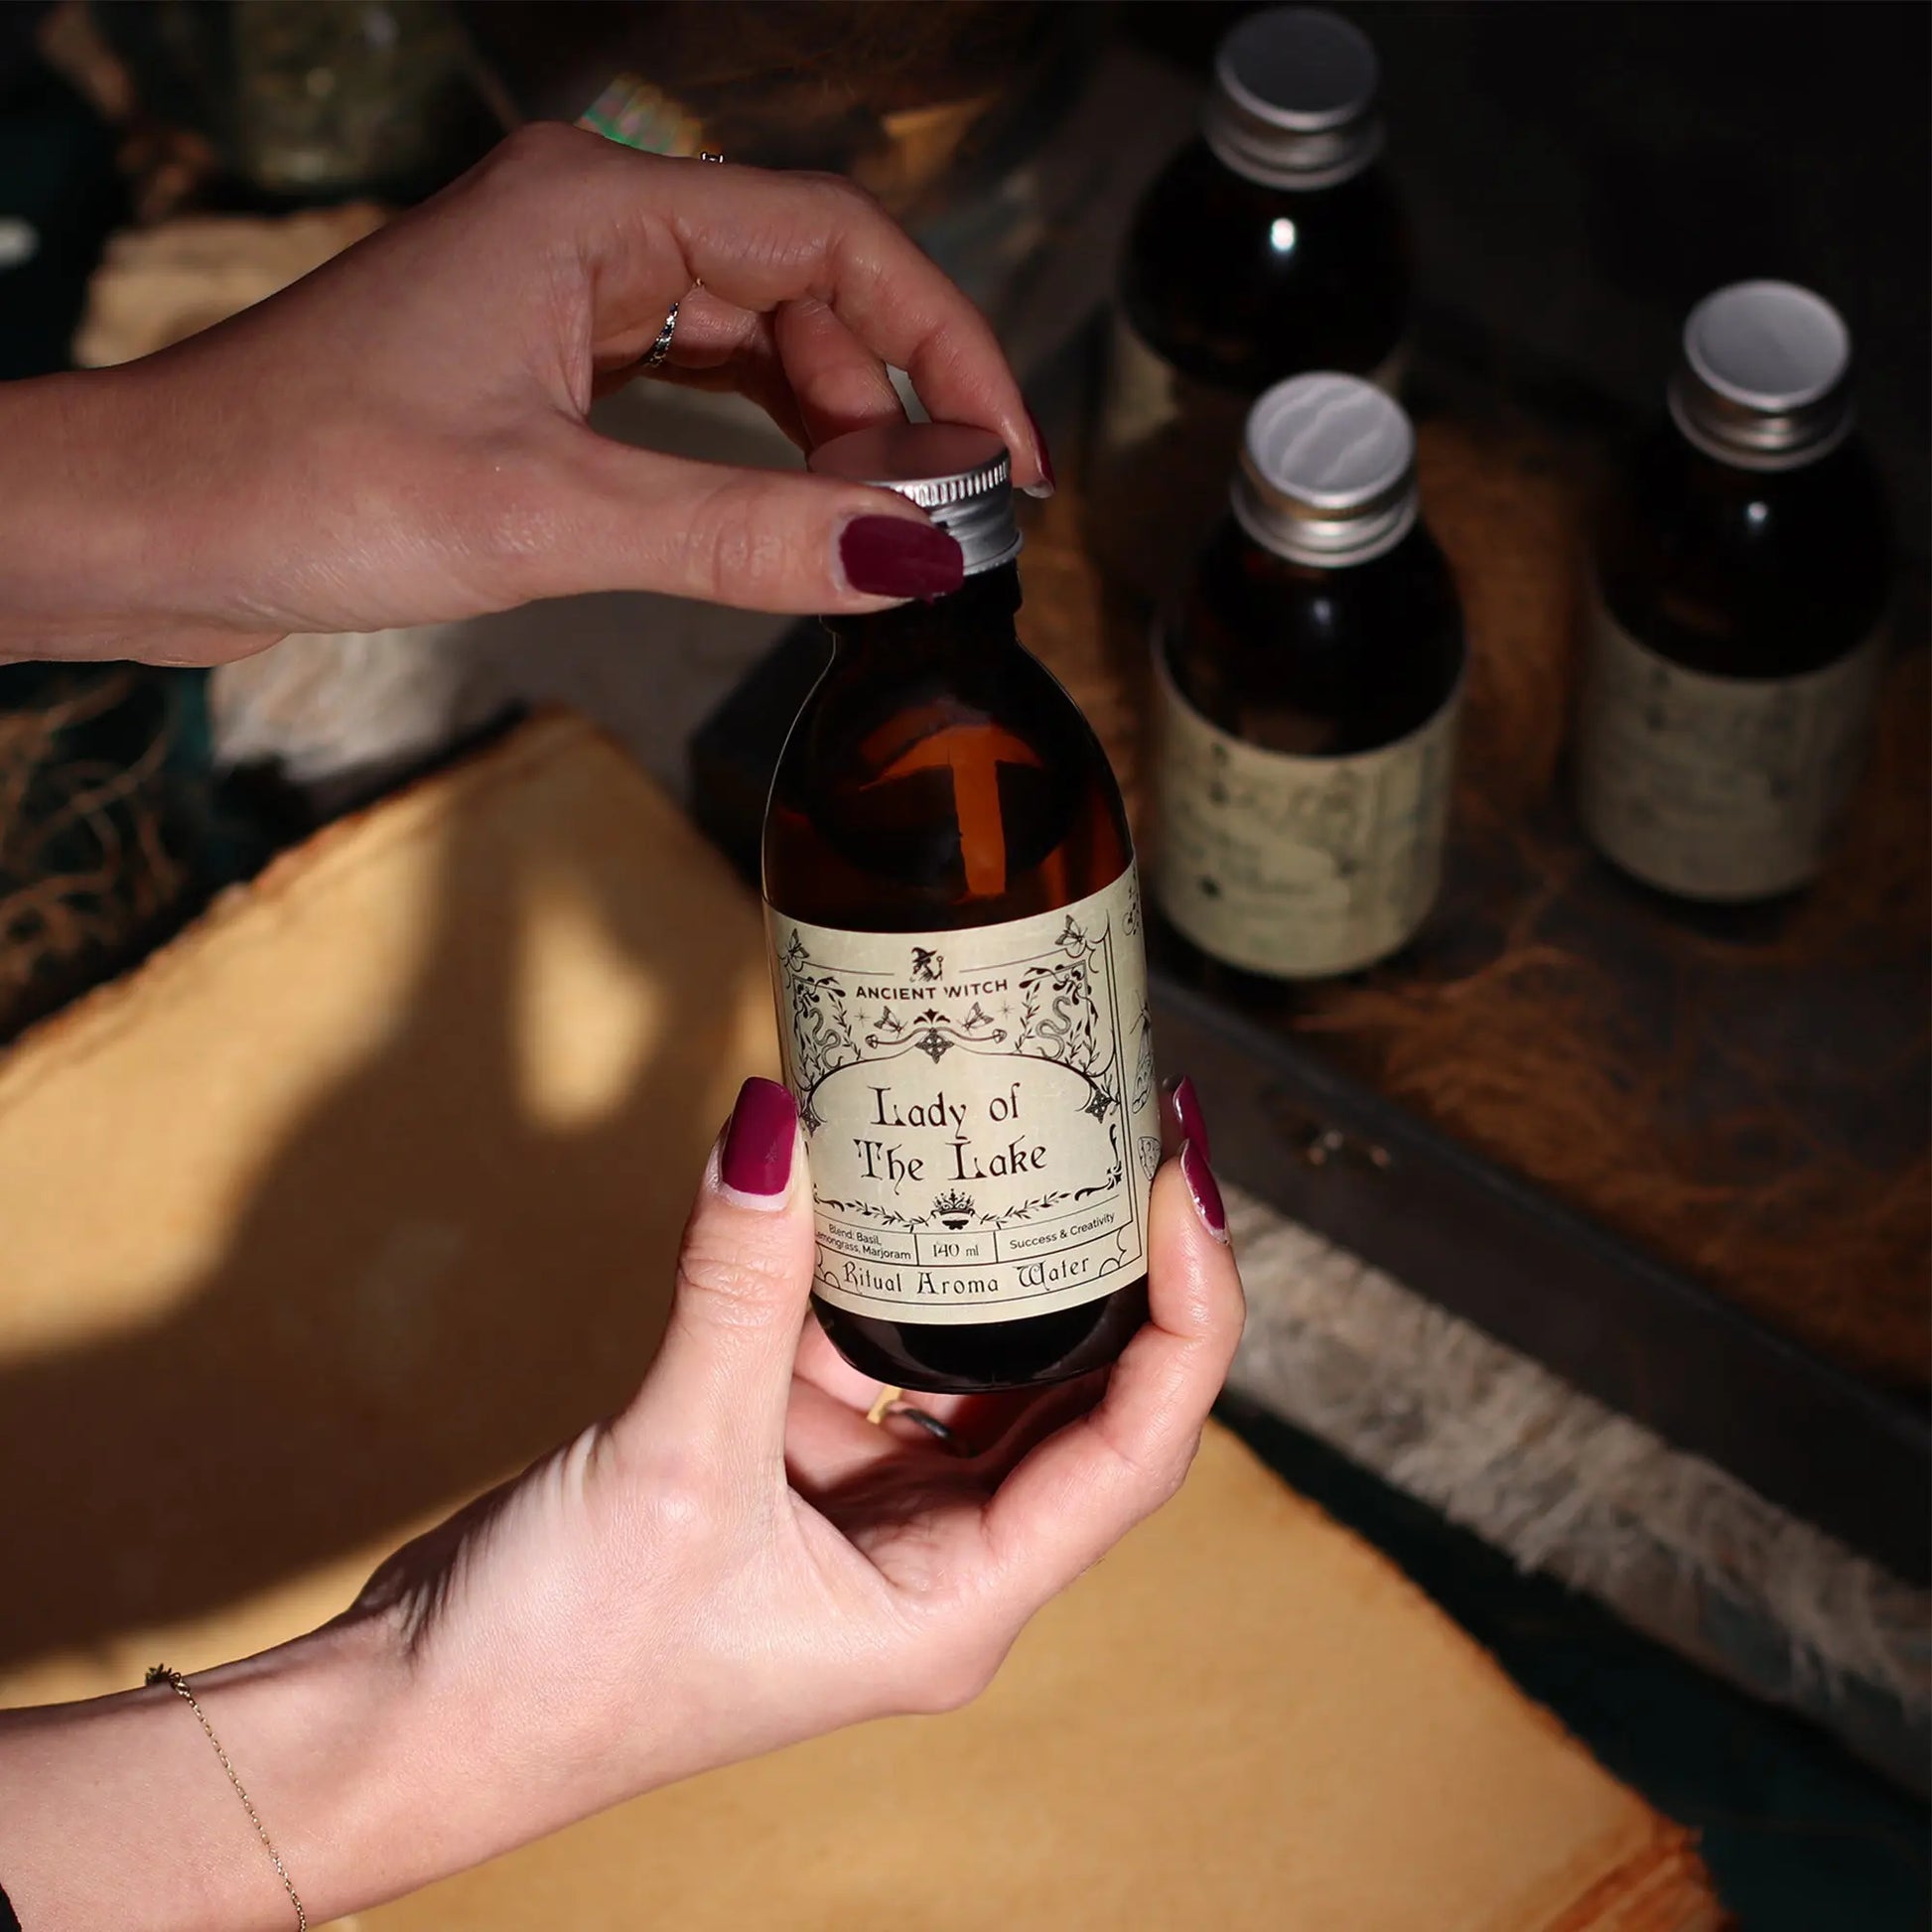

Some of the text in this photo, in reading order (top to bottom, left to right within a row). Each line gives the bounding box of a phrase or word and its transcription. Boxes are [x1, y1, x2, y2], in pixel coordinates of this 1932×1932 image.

[856, 979, 1008, 1000] ANCIENT WITCH
[867, 1082, 1021, 1140] Lady of
[853, 1135, 1047, 1195] The Lake
[815, 1230, 911, 1260] emongrass, Marjoram
[828, 1223, 855, 1239] Blend:
[1009, 1211, 1116, 1250] Success & Creativity
[932, 1243, 979, 1257] 140 ml
[842, 1257, 1089, 1295] Ritual Aroma Water
